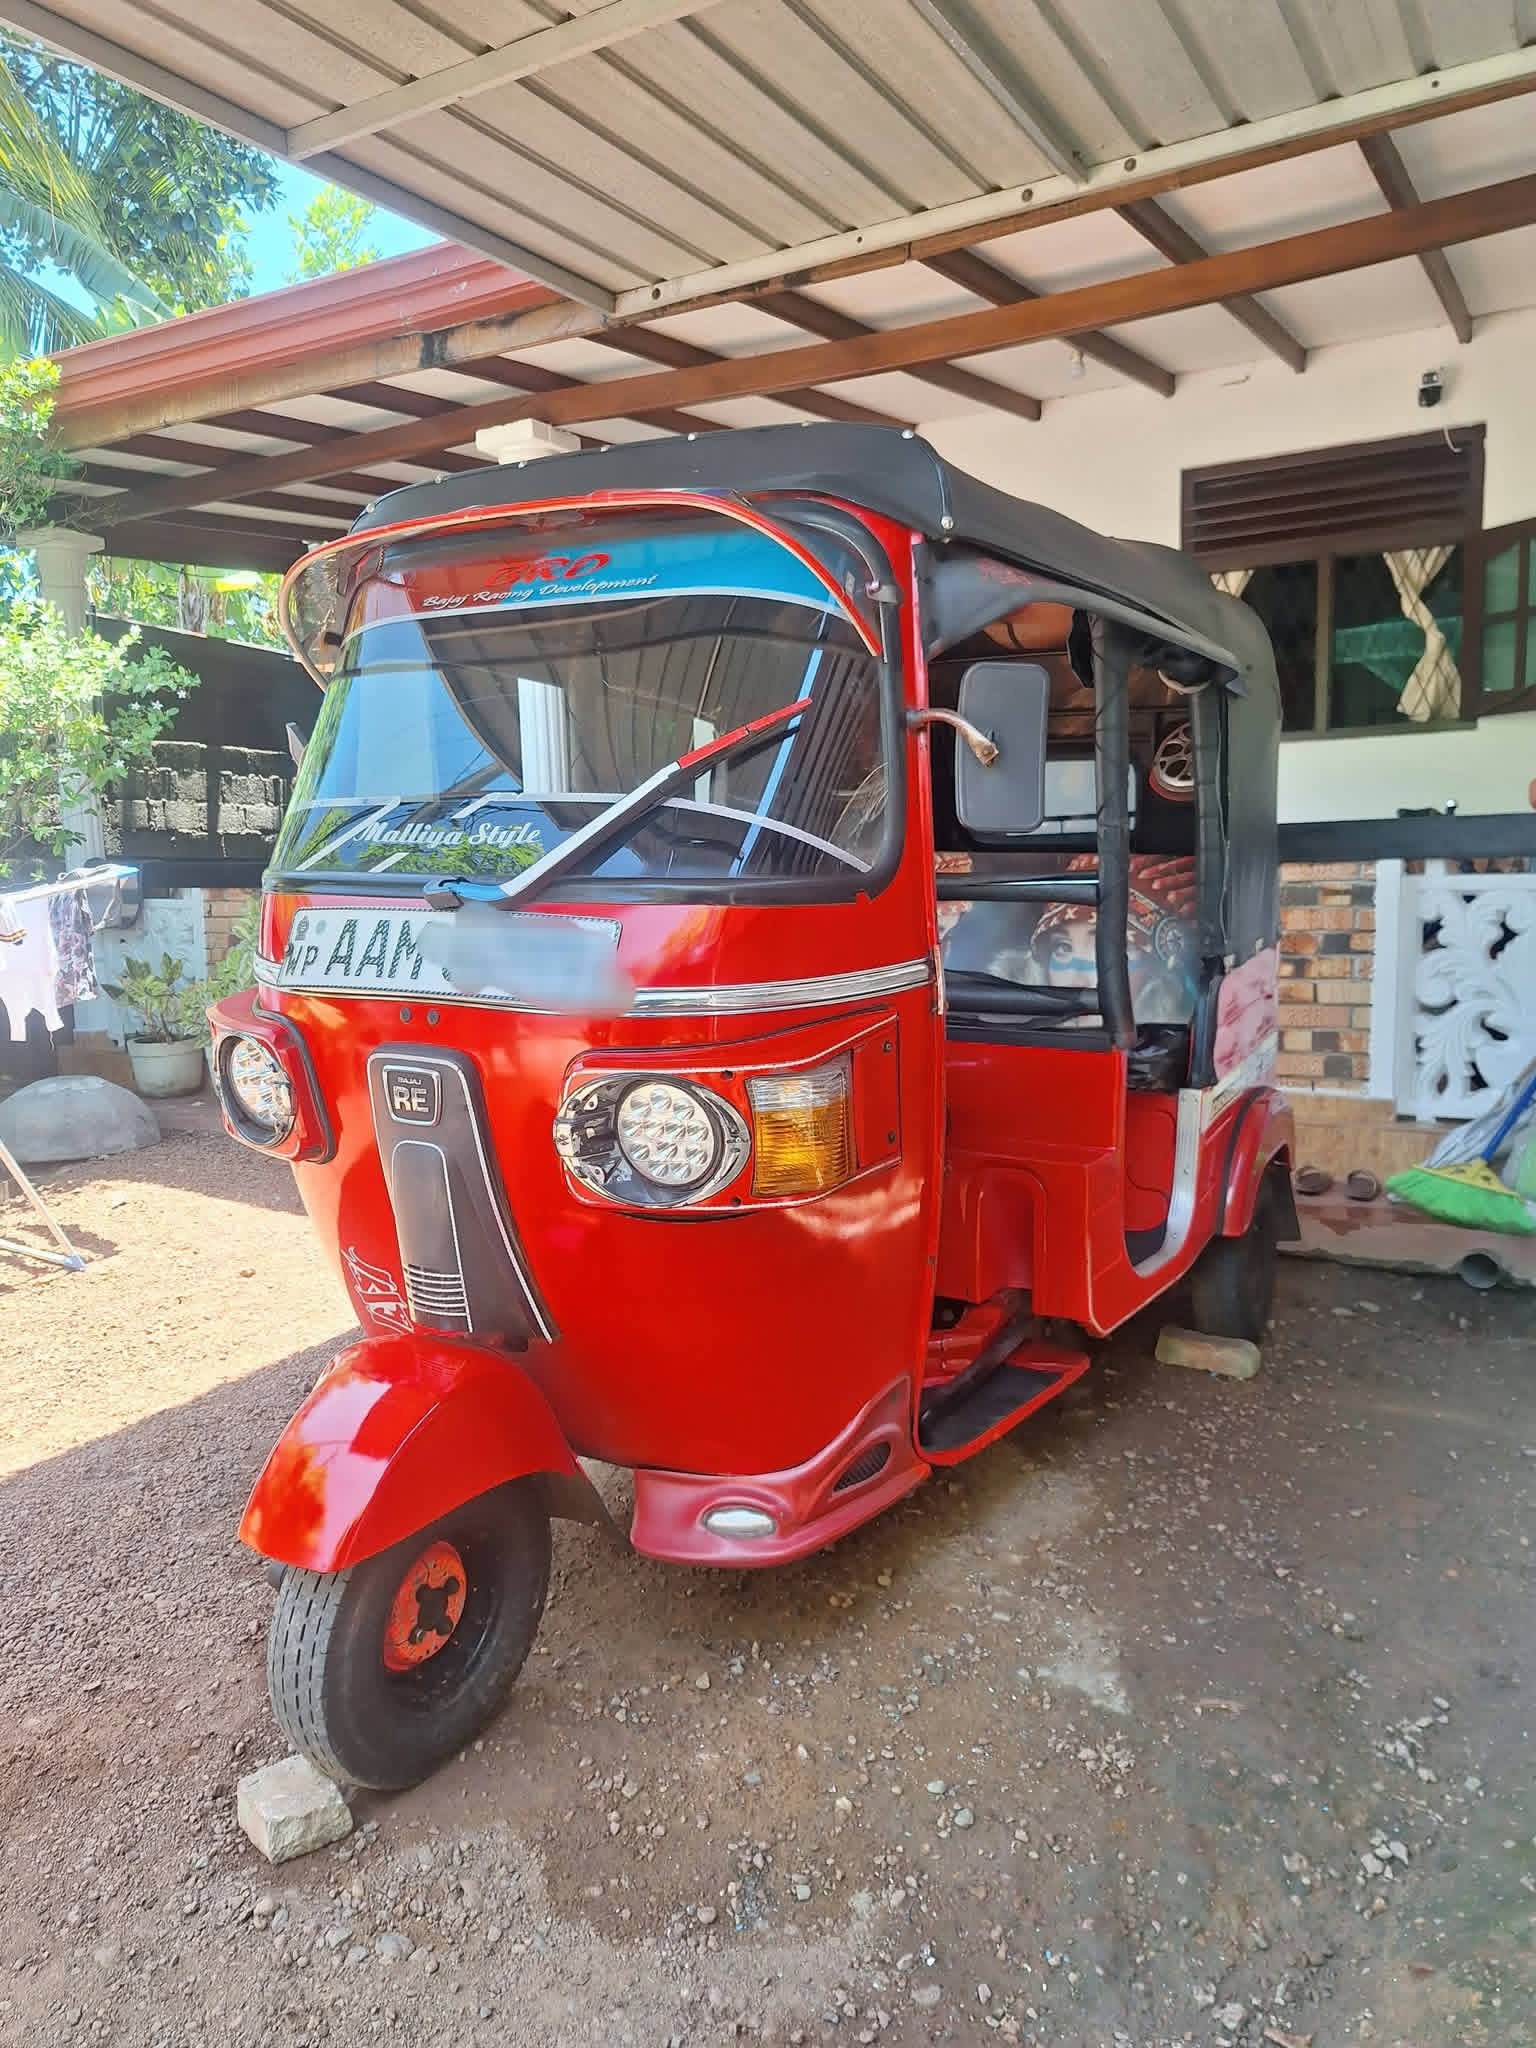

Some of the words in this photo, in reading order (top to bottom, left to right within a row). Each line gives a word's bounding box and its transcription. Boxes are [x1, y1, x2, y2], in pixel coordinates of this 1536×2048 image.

[423, 594, 469, 609] Bajaj
[473, 589, 534, 602] Racing
[540, 574, 658, 595] Development
[353, 822, 464, 848] Malliya
[469, 822, 543, 849] Style
[284, 945, 319, 976] WP
[397, 1076, 421, 1085] BAJAJ
[393, 1086, 430, 1112] RE
